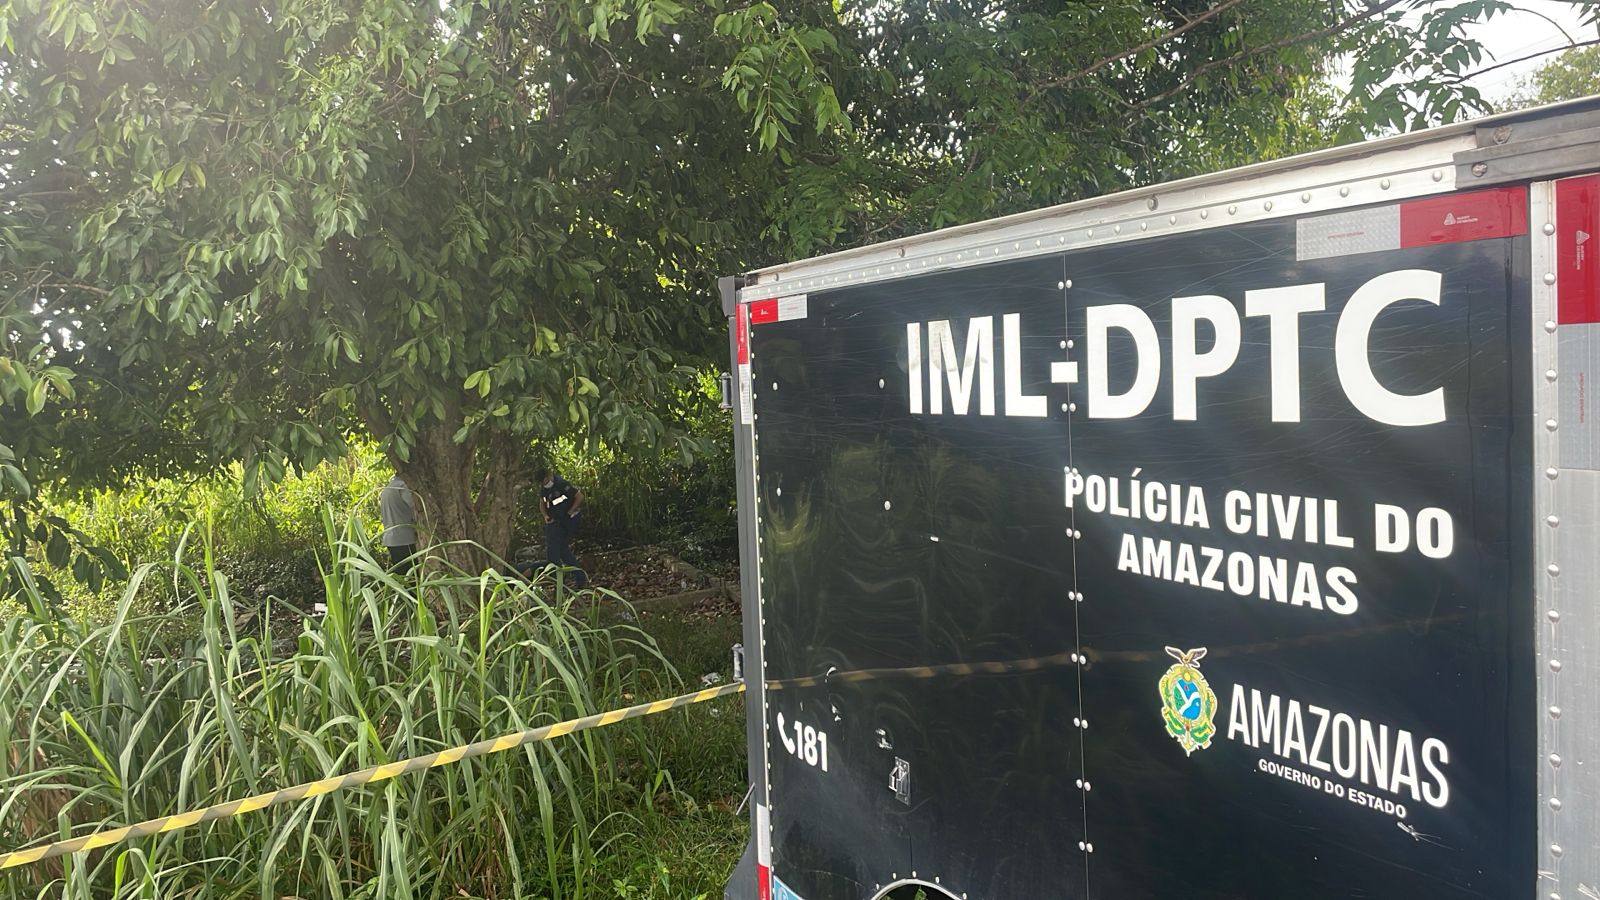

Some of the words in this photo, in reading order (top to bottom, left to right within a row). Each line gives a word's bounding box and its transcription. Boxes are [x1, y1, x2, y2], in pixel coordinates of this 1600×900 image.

[906, 269, 1447, 427] IML-DPTC
[1065, 467, 1211, 529] POLÍCIA
[1224, 490, 1355, 548] CIVIL
[1374, 503, 1455, 559] DO
[1117, 532, 1359, 615] AMAZONAS
[793, 720, 828, 773] 181
[1227, 683, 1450, 808] AMAZONAS
[1258, 758, 1321, 790] GOVERNO
[1324, 779, 1345, 798] DO
[1348, 788, 1407, 819] ESTADO
